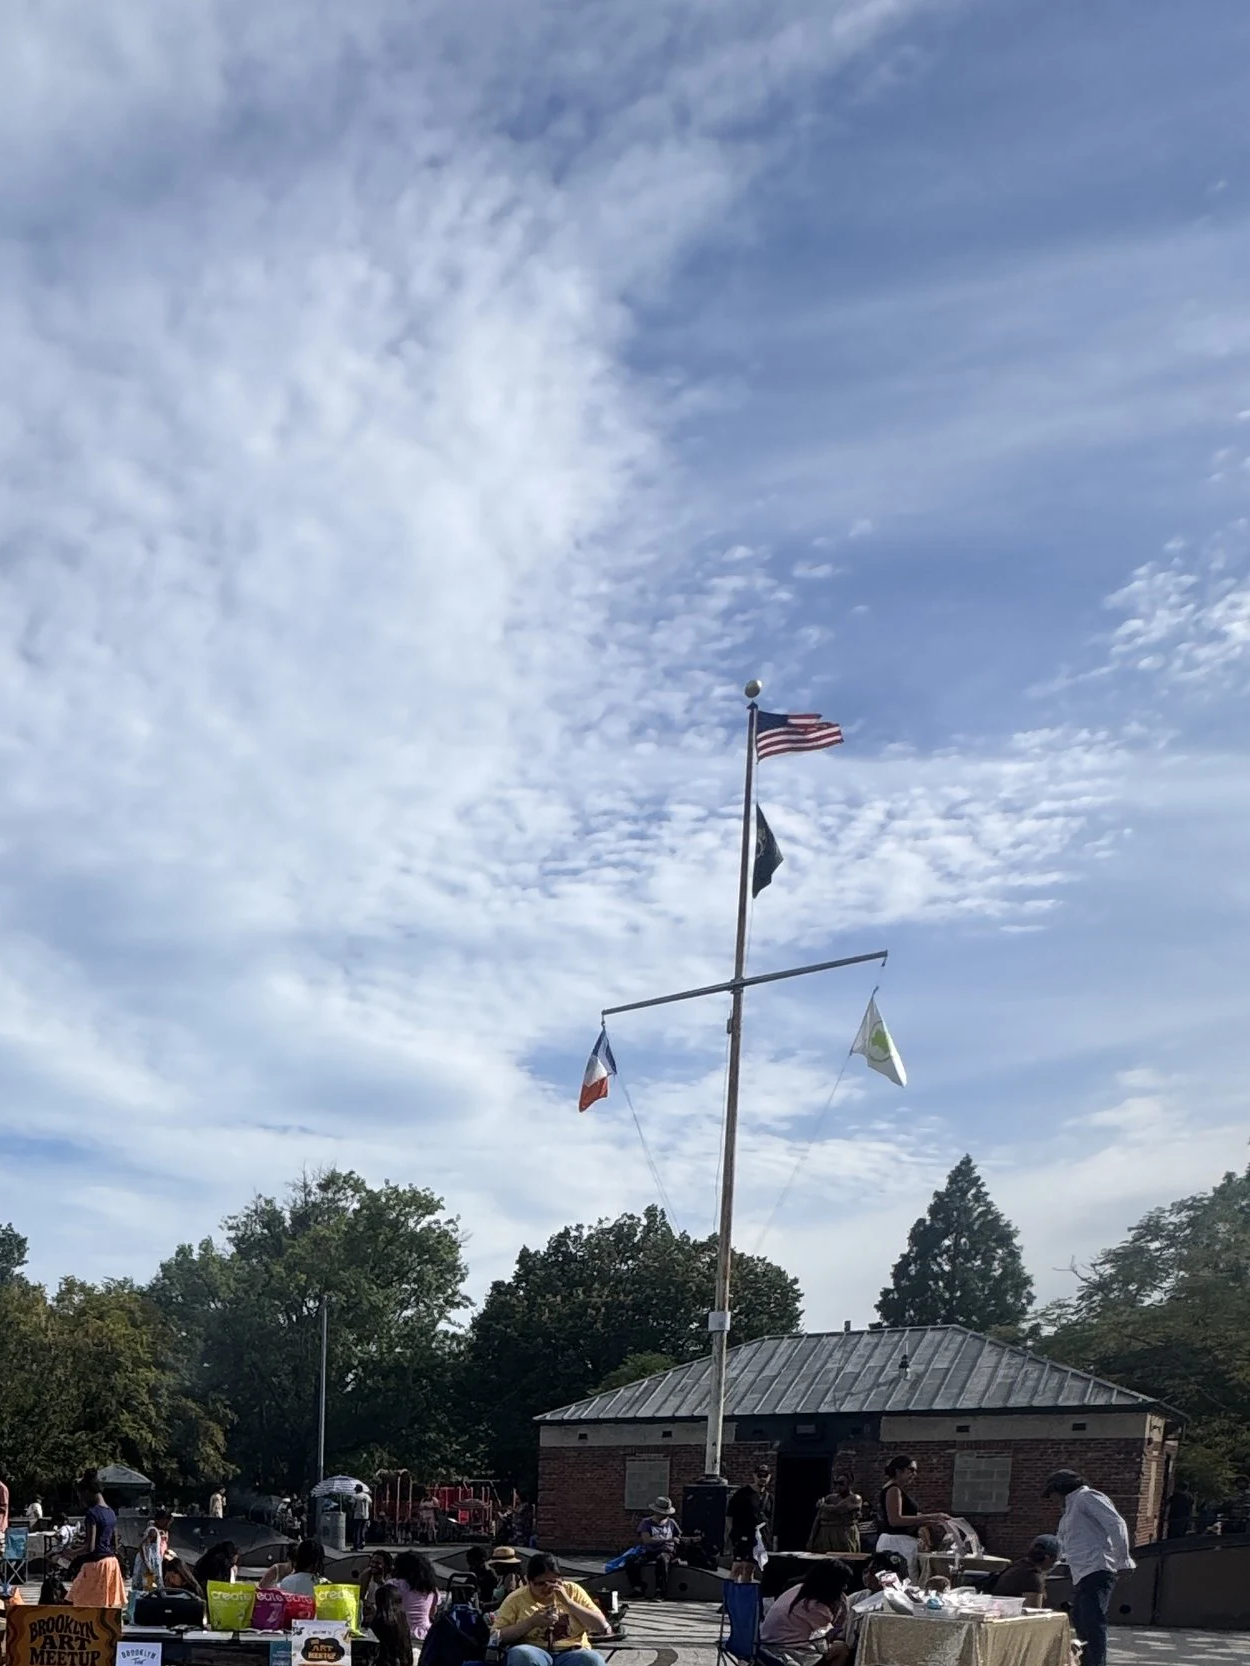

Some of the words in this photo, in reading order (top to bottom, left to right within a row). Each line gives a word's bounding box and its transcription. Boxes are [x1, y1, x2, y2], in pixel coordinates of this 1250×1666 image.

[211, 1590, 252, 1600] create
[256, 1591, 284, 1602] eate
[29, 1614, 99, 1643] BROOKLYN
[40, 1634, 91, 1650] ART
[311, 1644, 333, 1652] ART
[29, 1647, 101, 1666] MEETUP
[121, 1649, 157, 1659] BROOKLYN
